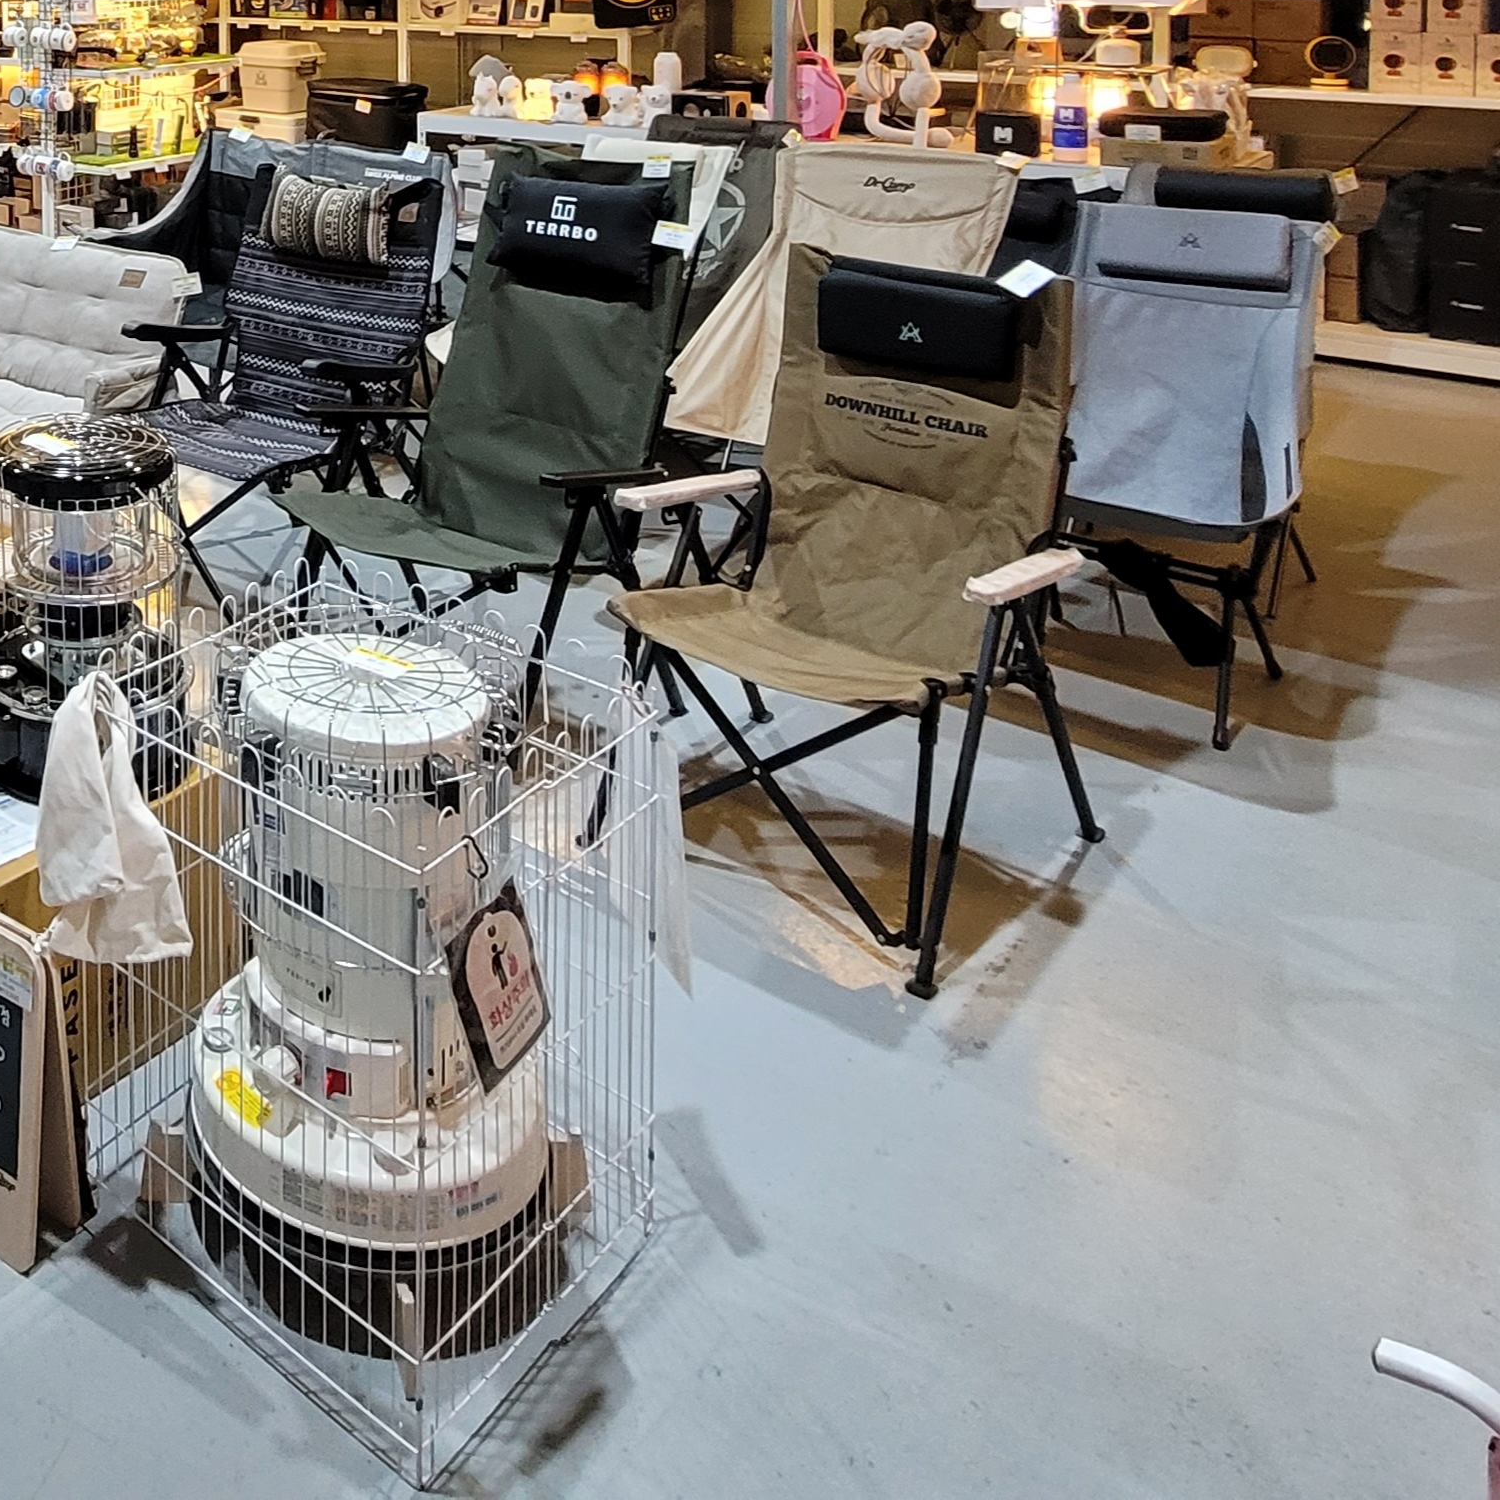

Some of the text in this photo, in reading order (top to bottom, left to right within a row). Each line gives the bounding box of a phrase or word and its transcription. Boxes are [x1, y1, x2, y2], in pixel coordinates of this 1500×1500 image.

[525, 219, 598, 242] TERRBO
[824, 392, 920, 425] DOWNHILL
[924, 415, 989, 438] CHAIR
